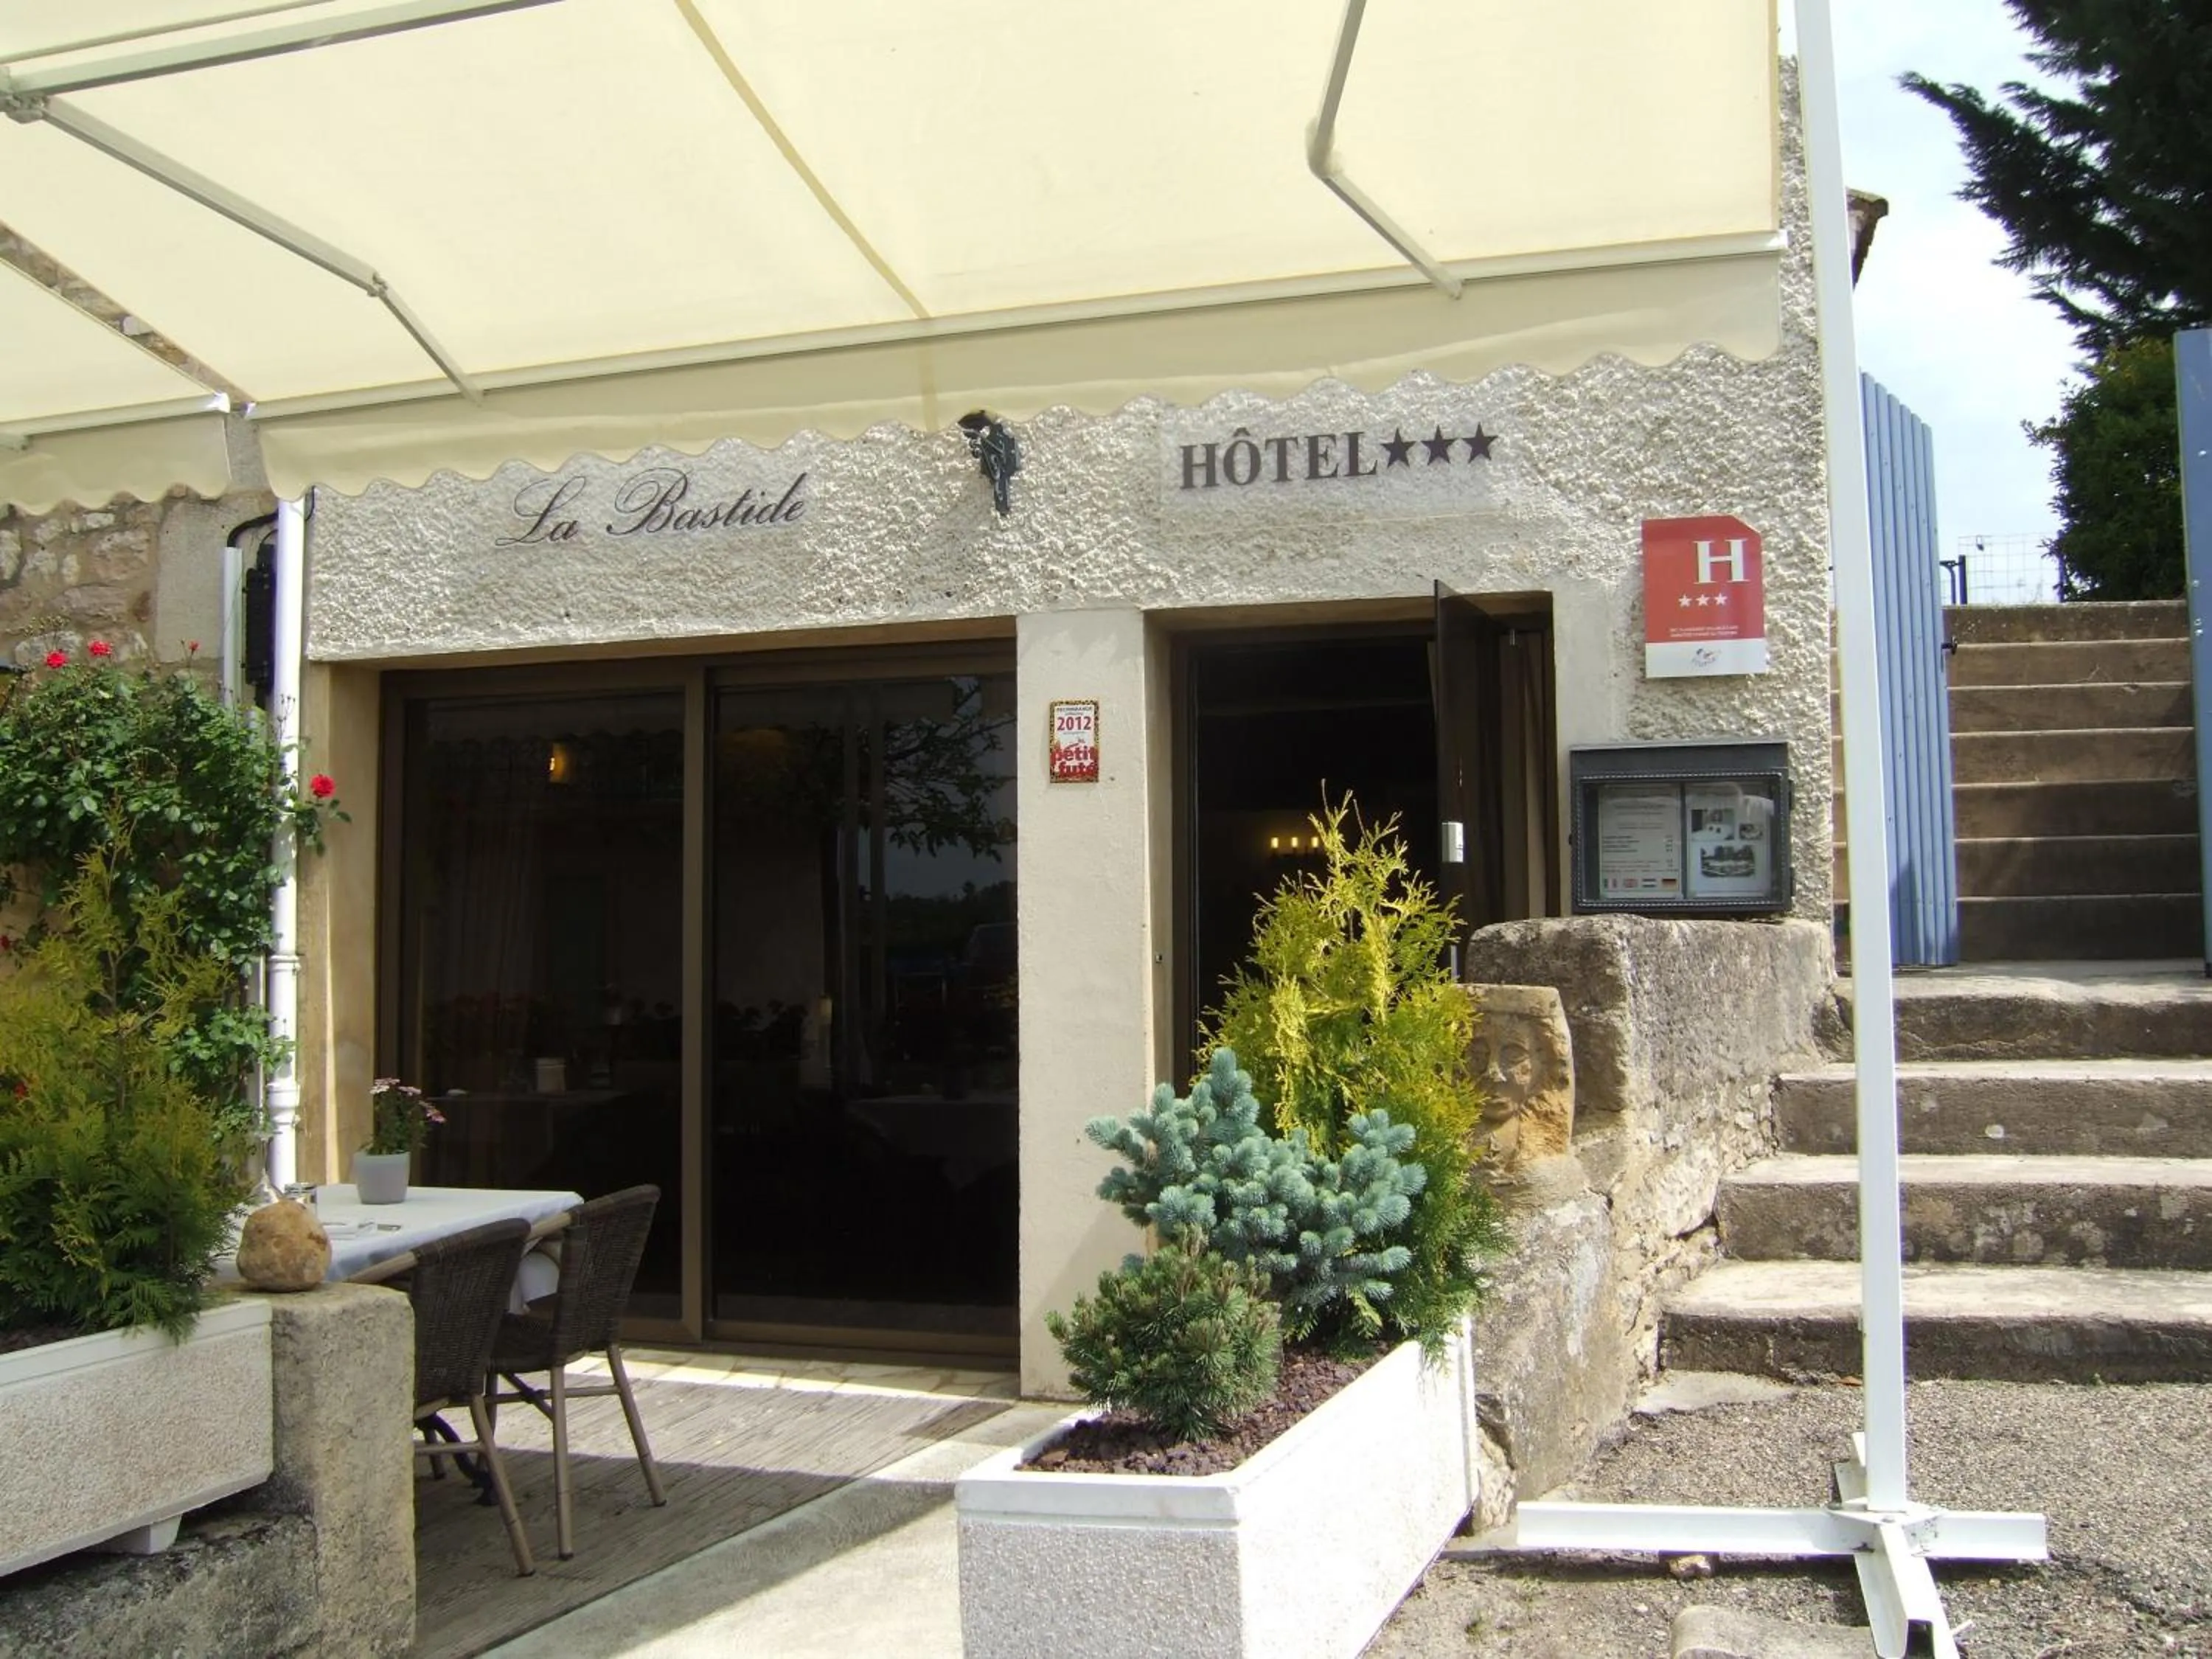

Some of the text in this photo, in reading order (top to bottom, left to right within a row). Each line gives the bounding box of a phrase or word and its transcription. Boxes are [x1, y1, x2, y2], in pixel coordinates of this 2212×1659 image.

[1180, 427, 1378, 490] HÔTEL
[495, 467, 807, 546] La Bastide
[1693, 538, 1750, 584] H
[1057, 716, 1092, 731] 2012
